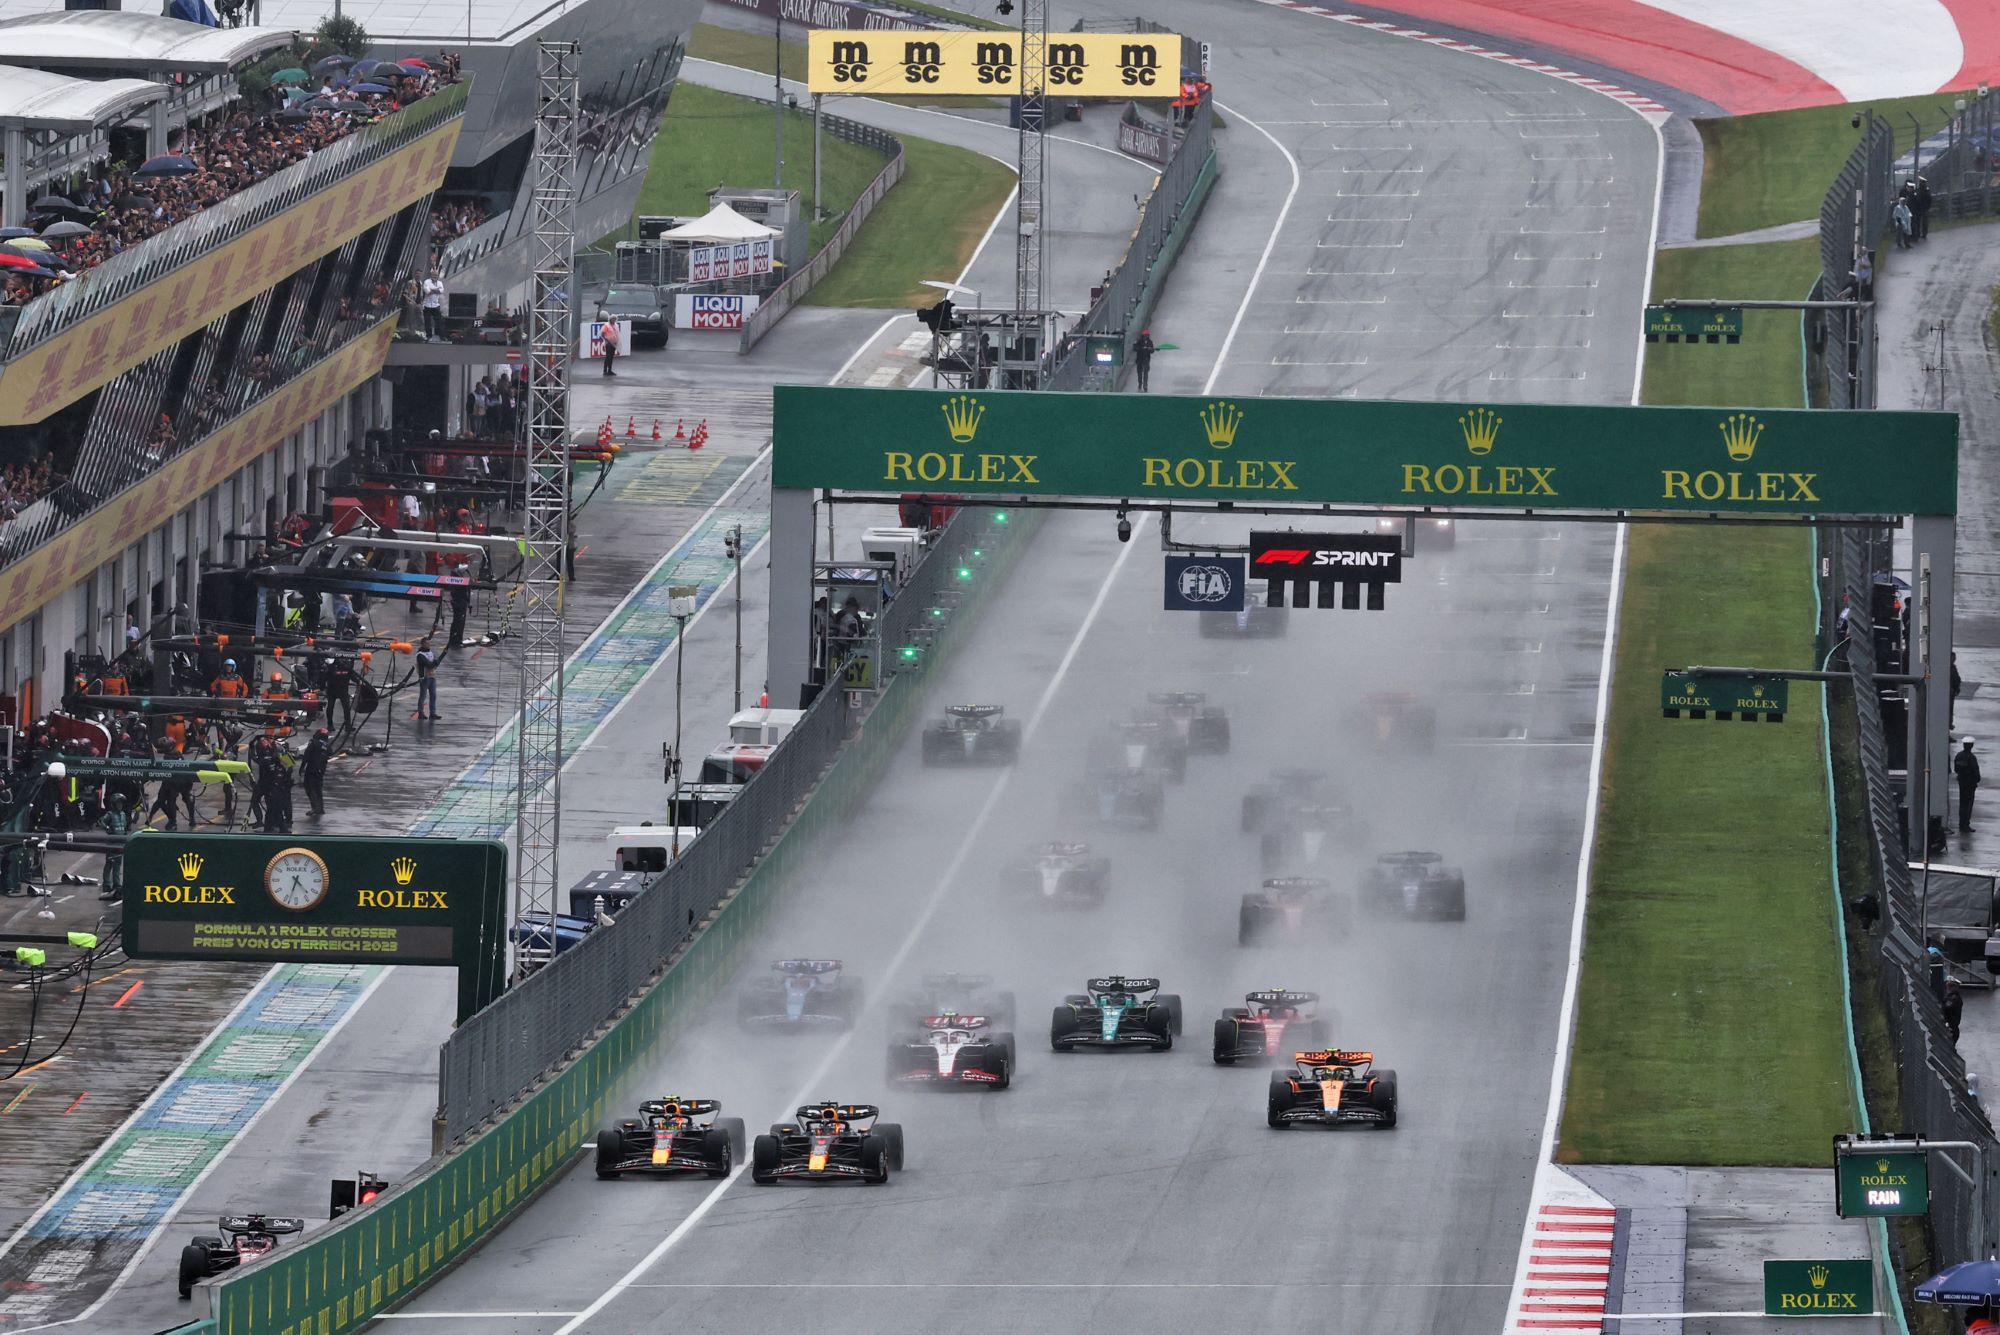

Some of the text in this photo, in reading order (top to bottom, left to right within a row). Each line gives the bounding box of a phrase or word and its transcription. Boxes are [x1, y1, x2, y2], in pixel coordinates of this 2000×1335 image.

[714, 263, 729, 278] MOLY
[734, 260, 749, 275] MOLY
[753, 257, 768, 272] MOLY
[694, 266, 710, 280] MOLY
[695, 296, 741, 312] LIQUI
[694, 312, 742, 329] MOLY
[1650, 324, 1683, 333] ROLEX
[1703, 324, 1736, 333] ROLEX
[884, 452, 1040, 484] ROLEX
[1142, 458, 1299, 490] ROLEX
[1401, 464, 1558, 496] ROLEX
[1661, 470, 1819, 502] ROLEX
[1312, 550, 1395, 567] SPRINT
[1669, 695, 1710, 707] ROLEX
[1737, 698, 1779, 710] ROLEX
[144, 885, 235, 904] ROLEX
[357, 889, 448, 909] ROLEX
[194, 924, 397, 938] FORMULA 1 ROLEX GROSSER
[193, 937, 234, 948] PREIS
[237, 939, 269, 949] VON
[362, 941, 398, 952] 2023
[1860, 1175, 1908, 1185] ROLEX
[1868, 1190, 1900, 1205] RAIN
[1781, 1293, 1857, 1308] ROLEX
